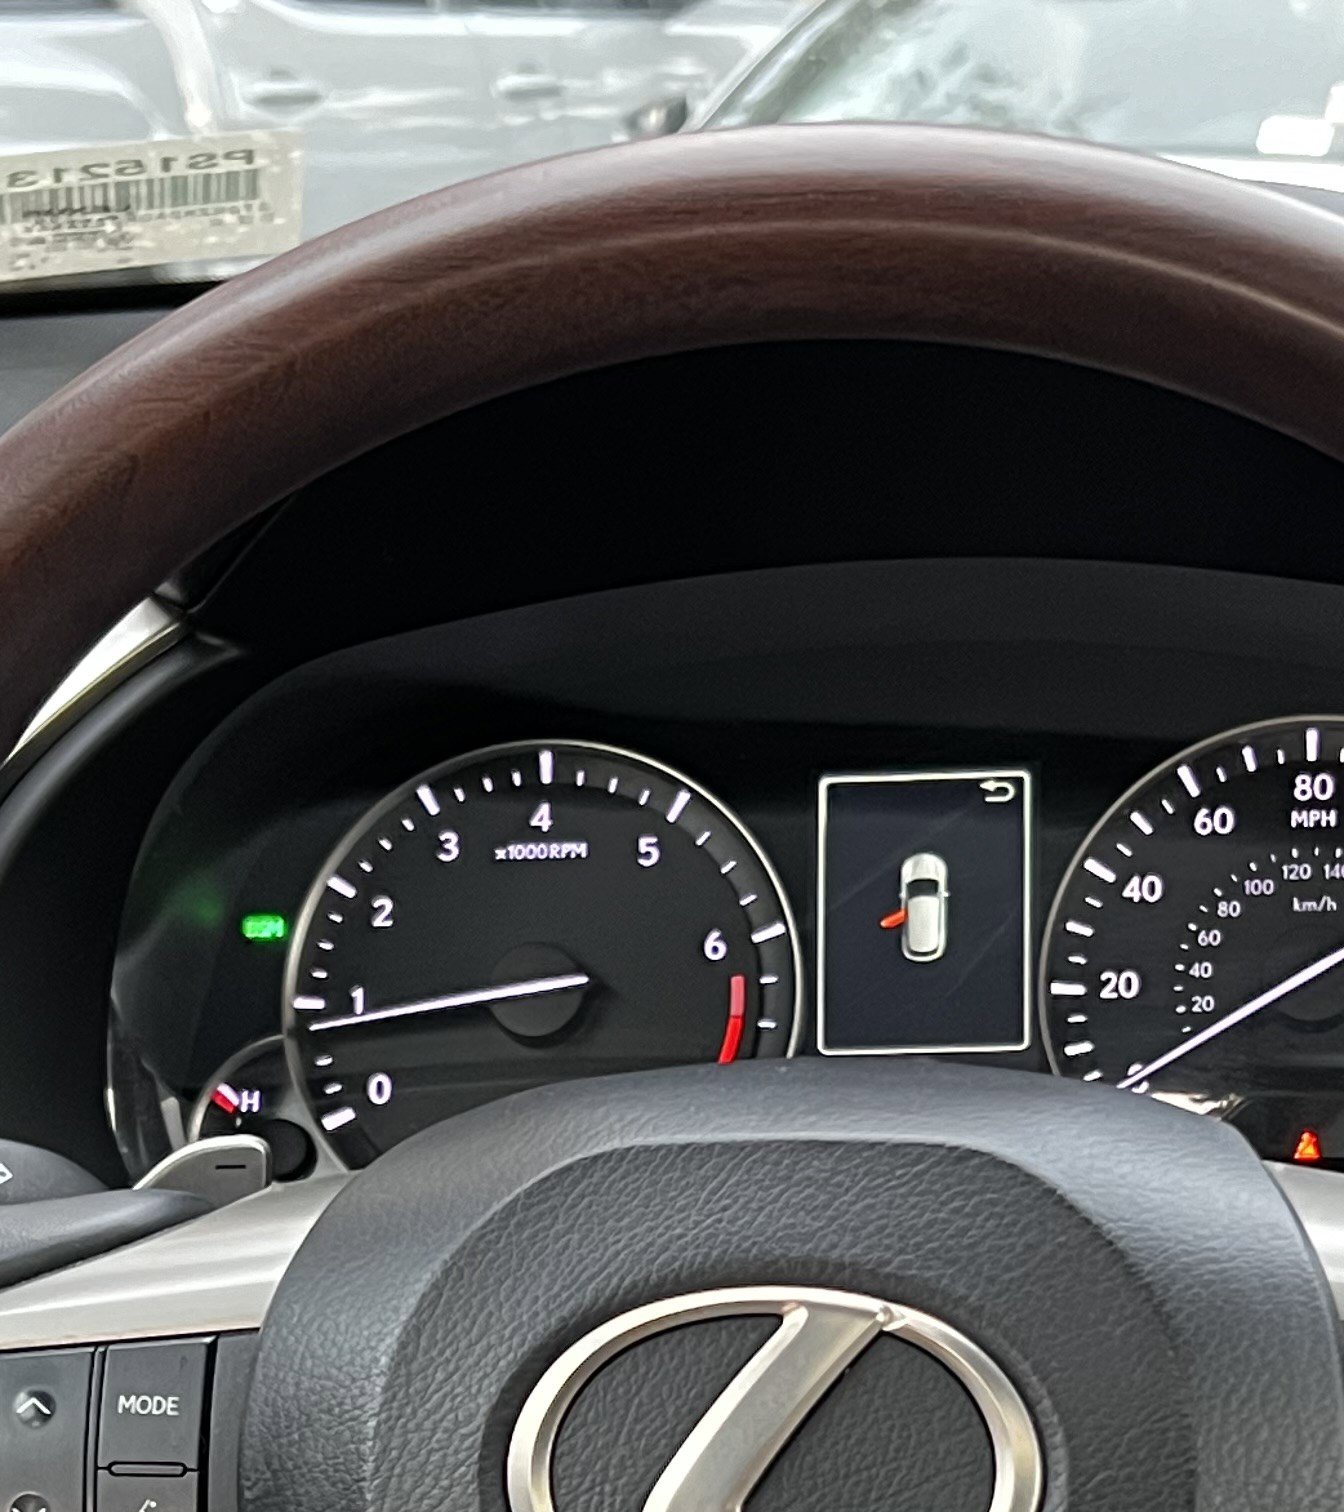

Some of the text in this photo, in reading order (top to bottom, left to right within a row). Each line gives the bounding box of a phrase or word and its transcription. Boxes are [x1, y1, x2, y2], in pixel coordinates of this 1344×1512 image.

[1293, 772, 1335, 802] 80
[529, 802, 553, 832] 4
[1193, 806, 1235, 836] 60
[1290, 809, 1337, 828] MPH
[437, 832, 460, 862] 3
[637, 836, 660, 867] 5
[1281, 863, 1312, 880] 120
[1121, 874, 1163, 903] 40
[1244, 878, 1275, 896] 100
[371, 896, 394, 927] 2
[1217, 900, 1241, 918] 80
[1293, 895, 1337, 913] km/h
[703, 930, 727, 961] 6
[1197, 928, 1221, 947] 60
[1188, 961, 1213, 979] 40
[1099, 970, 1140, 999] 20
[351, 987, 366, 1013] 1
[1191, 995, 1215, 1013] 20
[241, 1090, 261, 1113] H
[367, 1072, 393, 1105] 0
[118, 1394, 180, 1416] MODE
